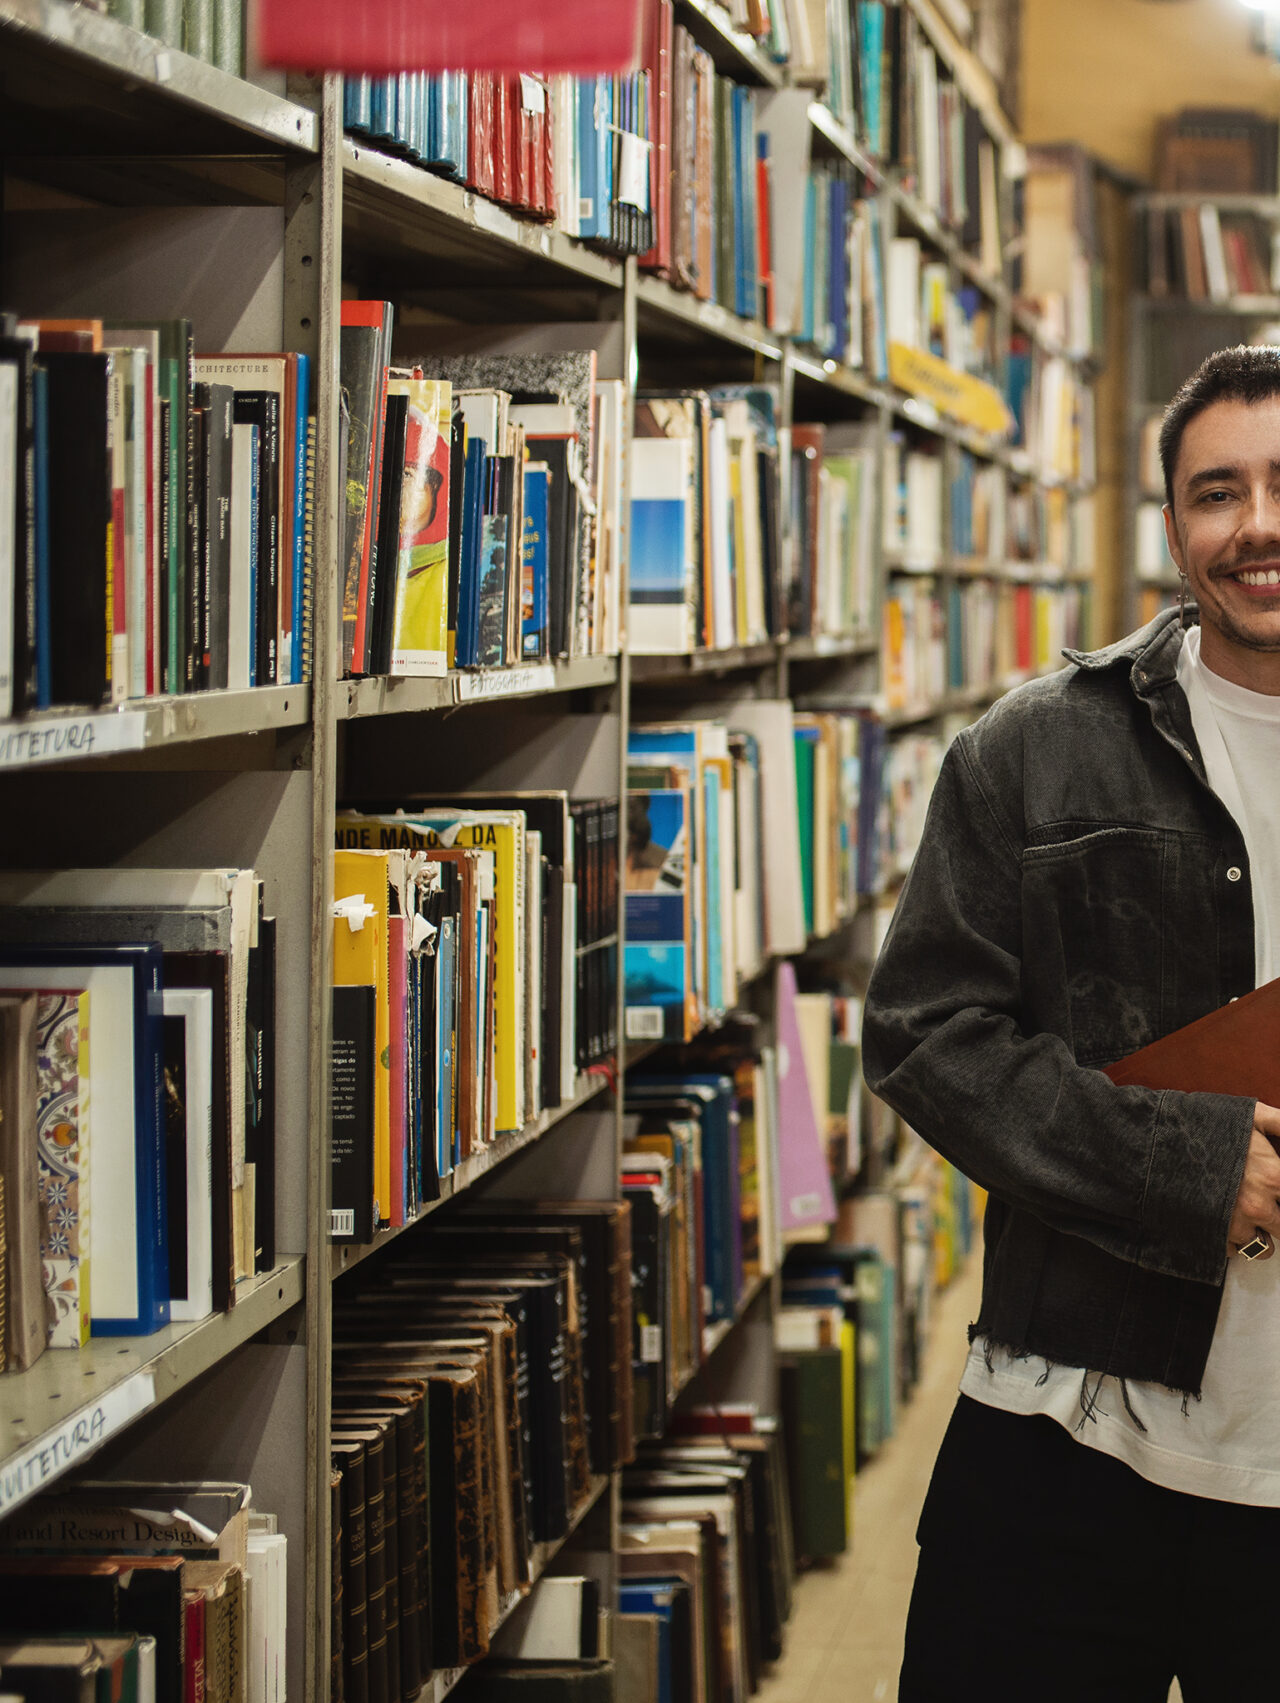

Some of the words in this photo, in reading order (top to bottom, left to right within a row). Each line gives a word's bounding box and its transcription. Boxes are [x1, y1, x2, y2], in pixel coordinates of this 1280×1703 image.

[194, 365, 269, 373] CHITECTURE
[380, 828, 463, 849] MANUL
[472, 824, 497, 845] DA
[61, 1521, 125, 1543] Resort
